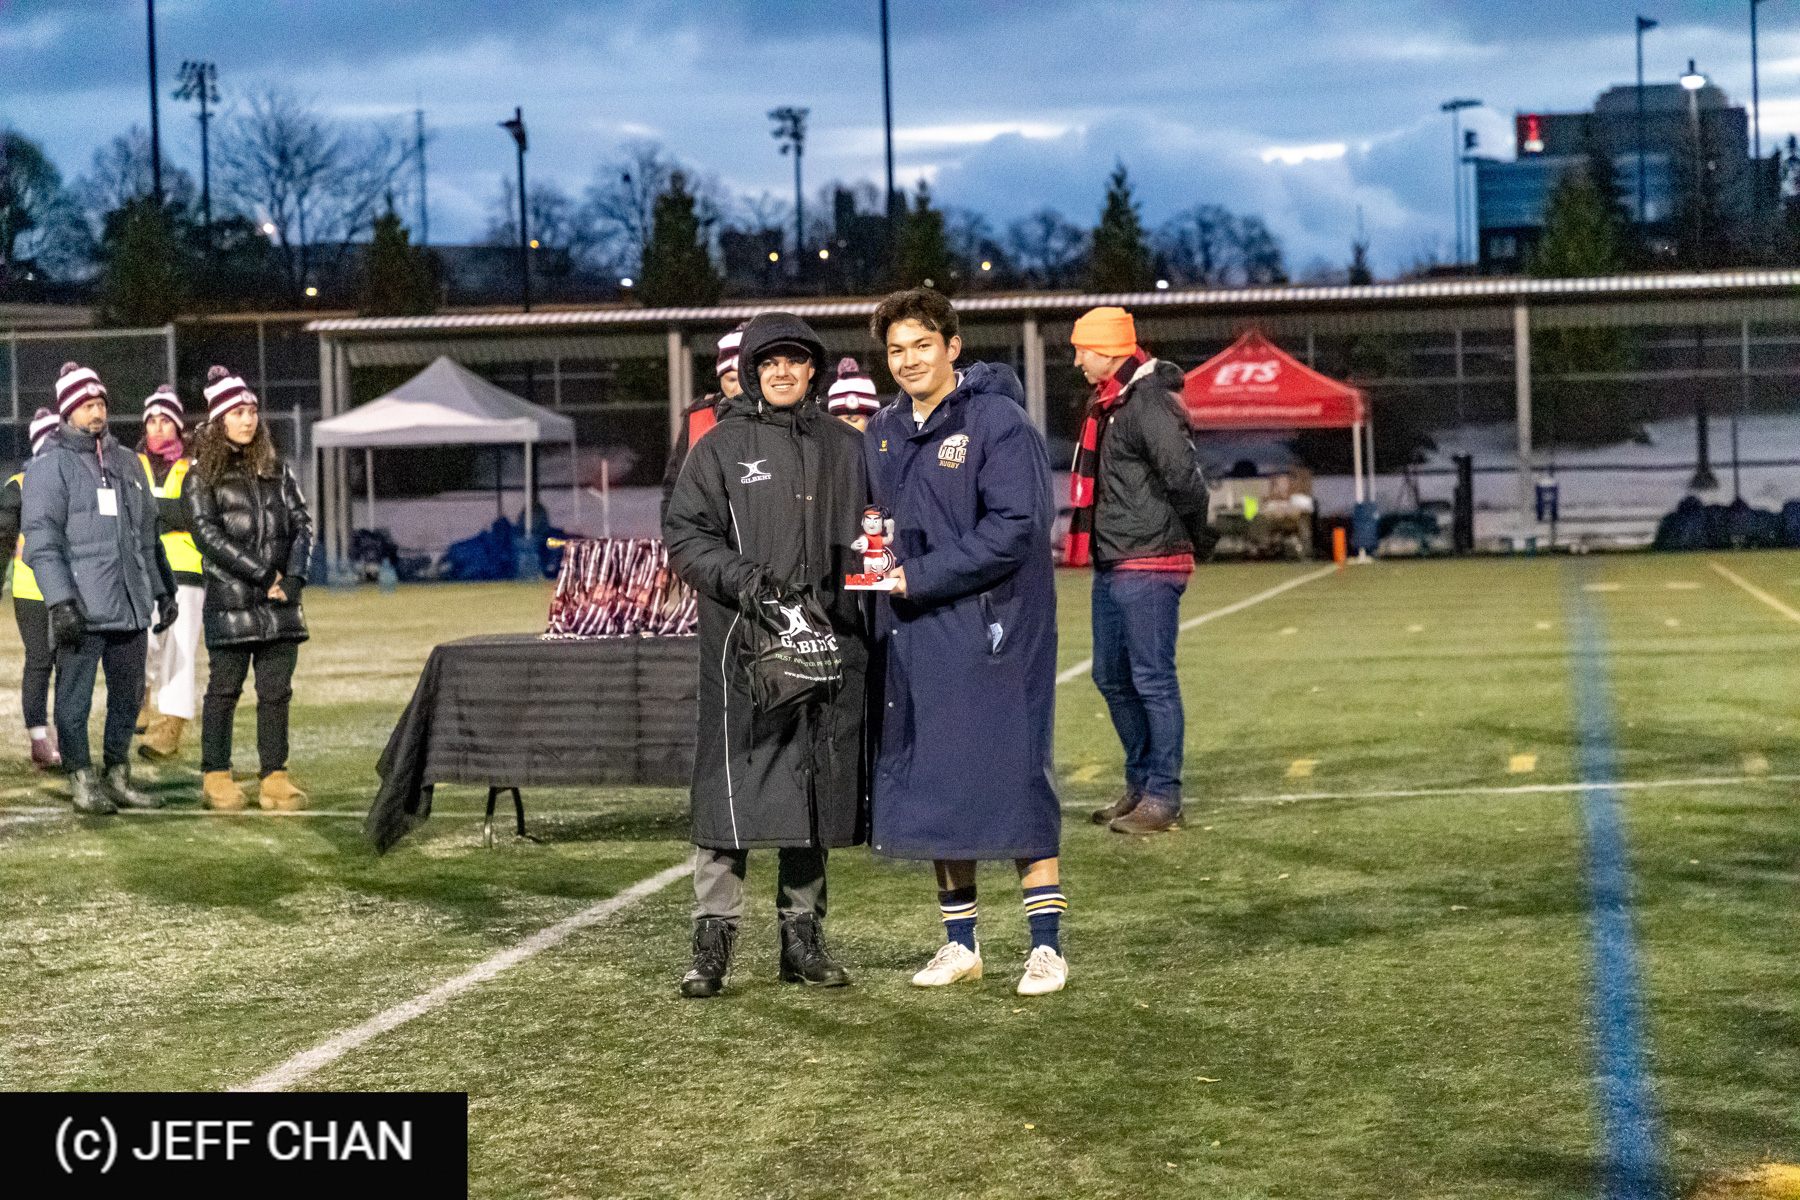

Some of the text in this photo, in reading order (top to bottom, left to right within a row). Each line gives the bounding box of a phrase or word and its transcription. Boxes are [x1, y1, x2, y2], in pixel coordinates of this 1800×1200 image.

[938, 444, 967, 463] UBC
[939, 460, 960, 469] RUGBY
[741, 474, 772, 484] GILBERT
[845, 573, 878, 586] MVP
